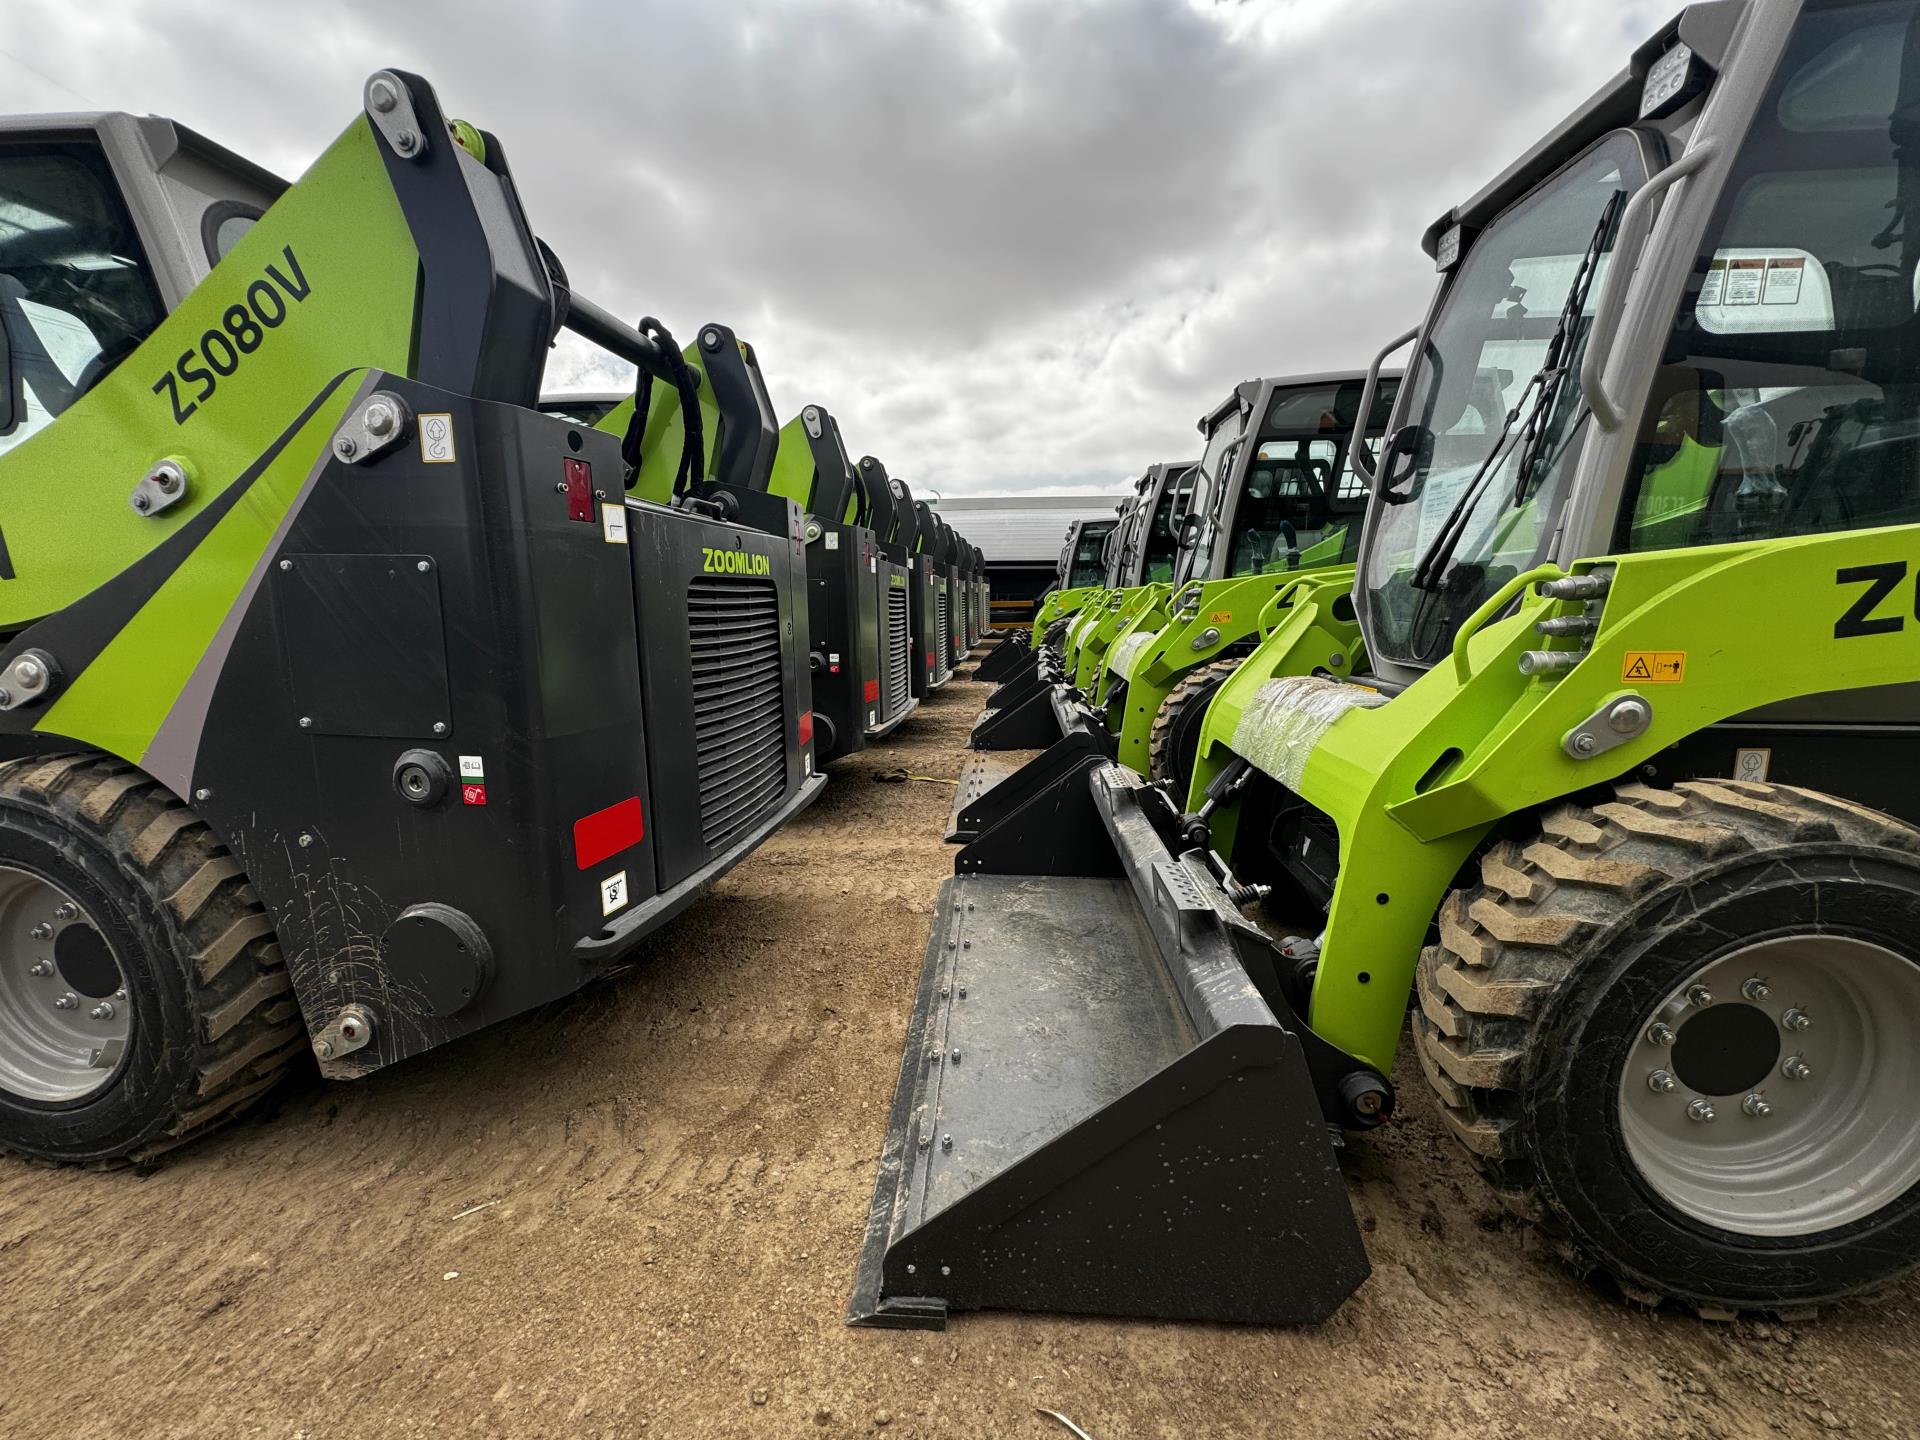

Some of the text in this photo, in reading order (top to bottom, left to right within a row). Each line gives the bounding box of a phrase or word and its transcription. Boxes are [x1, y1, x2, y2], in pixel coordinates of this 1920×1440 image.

[152, 244, 311, 425] ZS080V
[702, 547, 770, 576] ZOOMLION
[1834, 560, 1920, 639] Z
